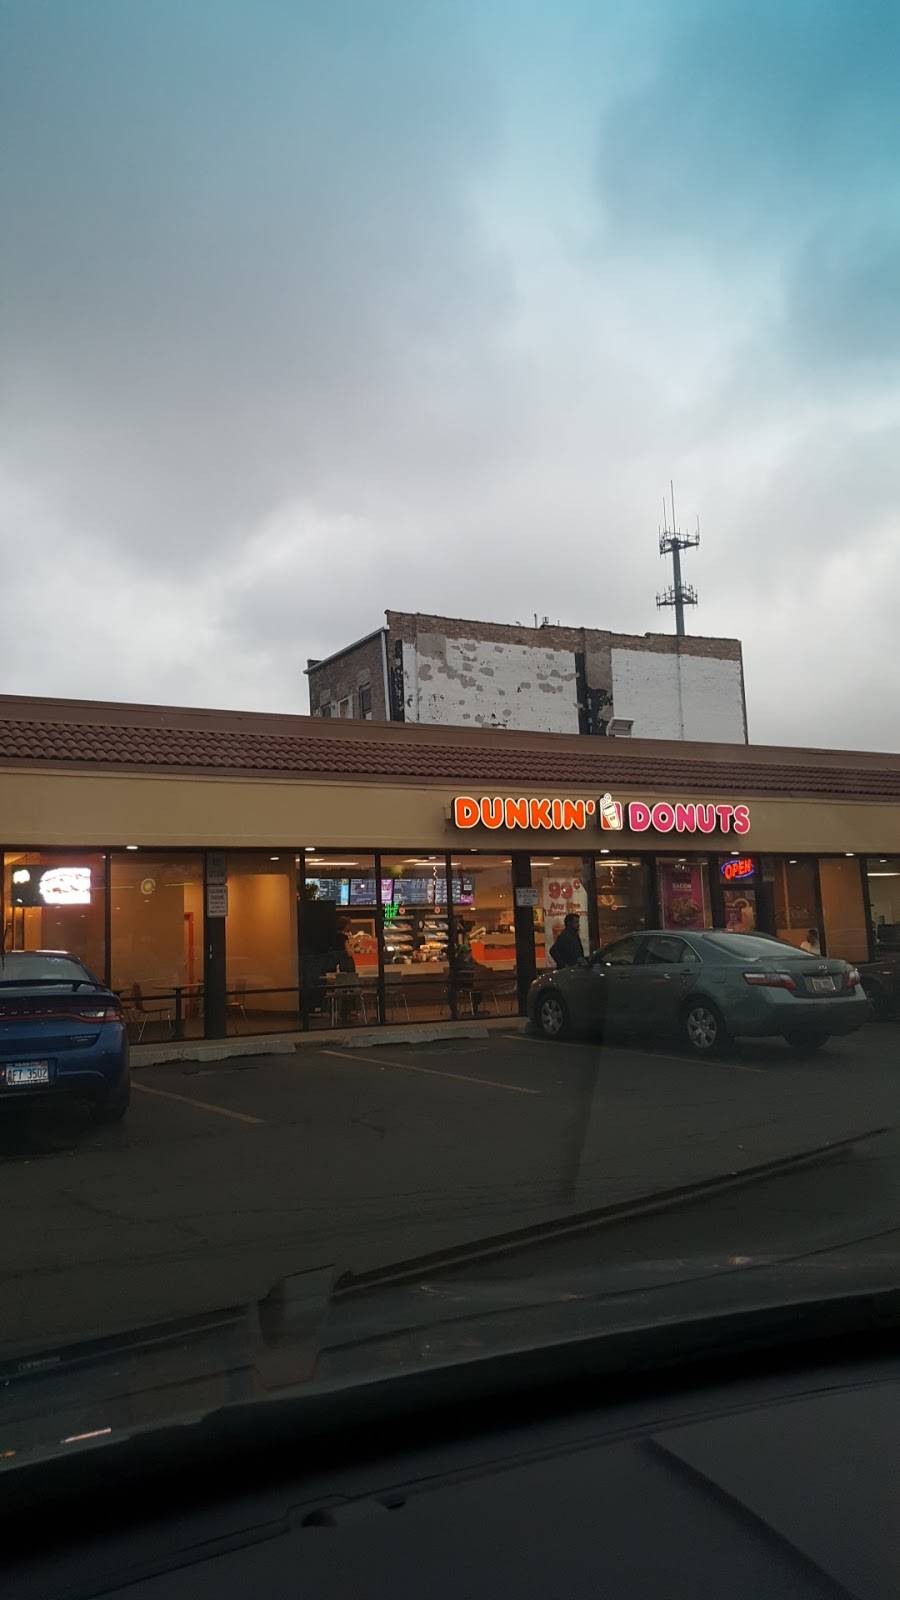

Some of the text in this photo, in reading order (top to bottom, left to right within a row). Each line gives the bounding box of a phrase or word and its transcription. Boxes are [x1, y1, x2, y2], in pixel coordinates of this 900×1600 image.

[454, 796, 750, 834] DUNKIN' DONUTS
[724, 858, 752, 880] OPEN
